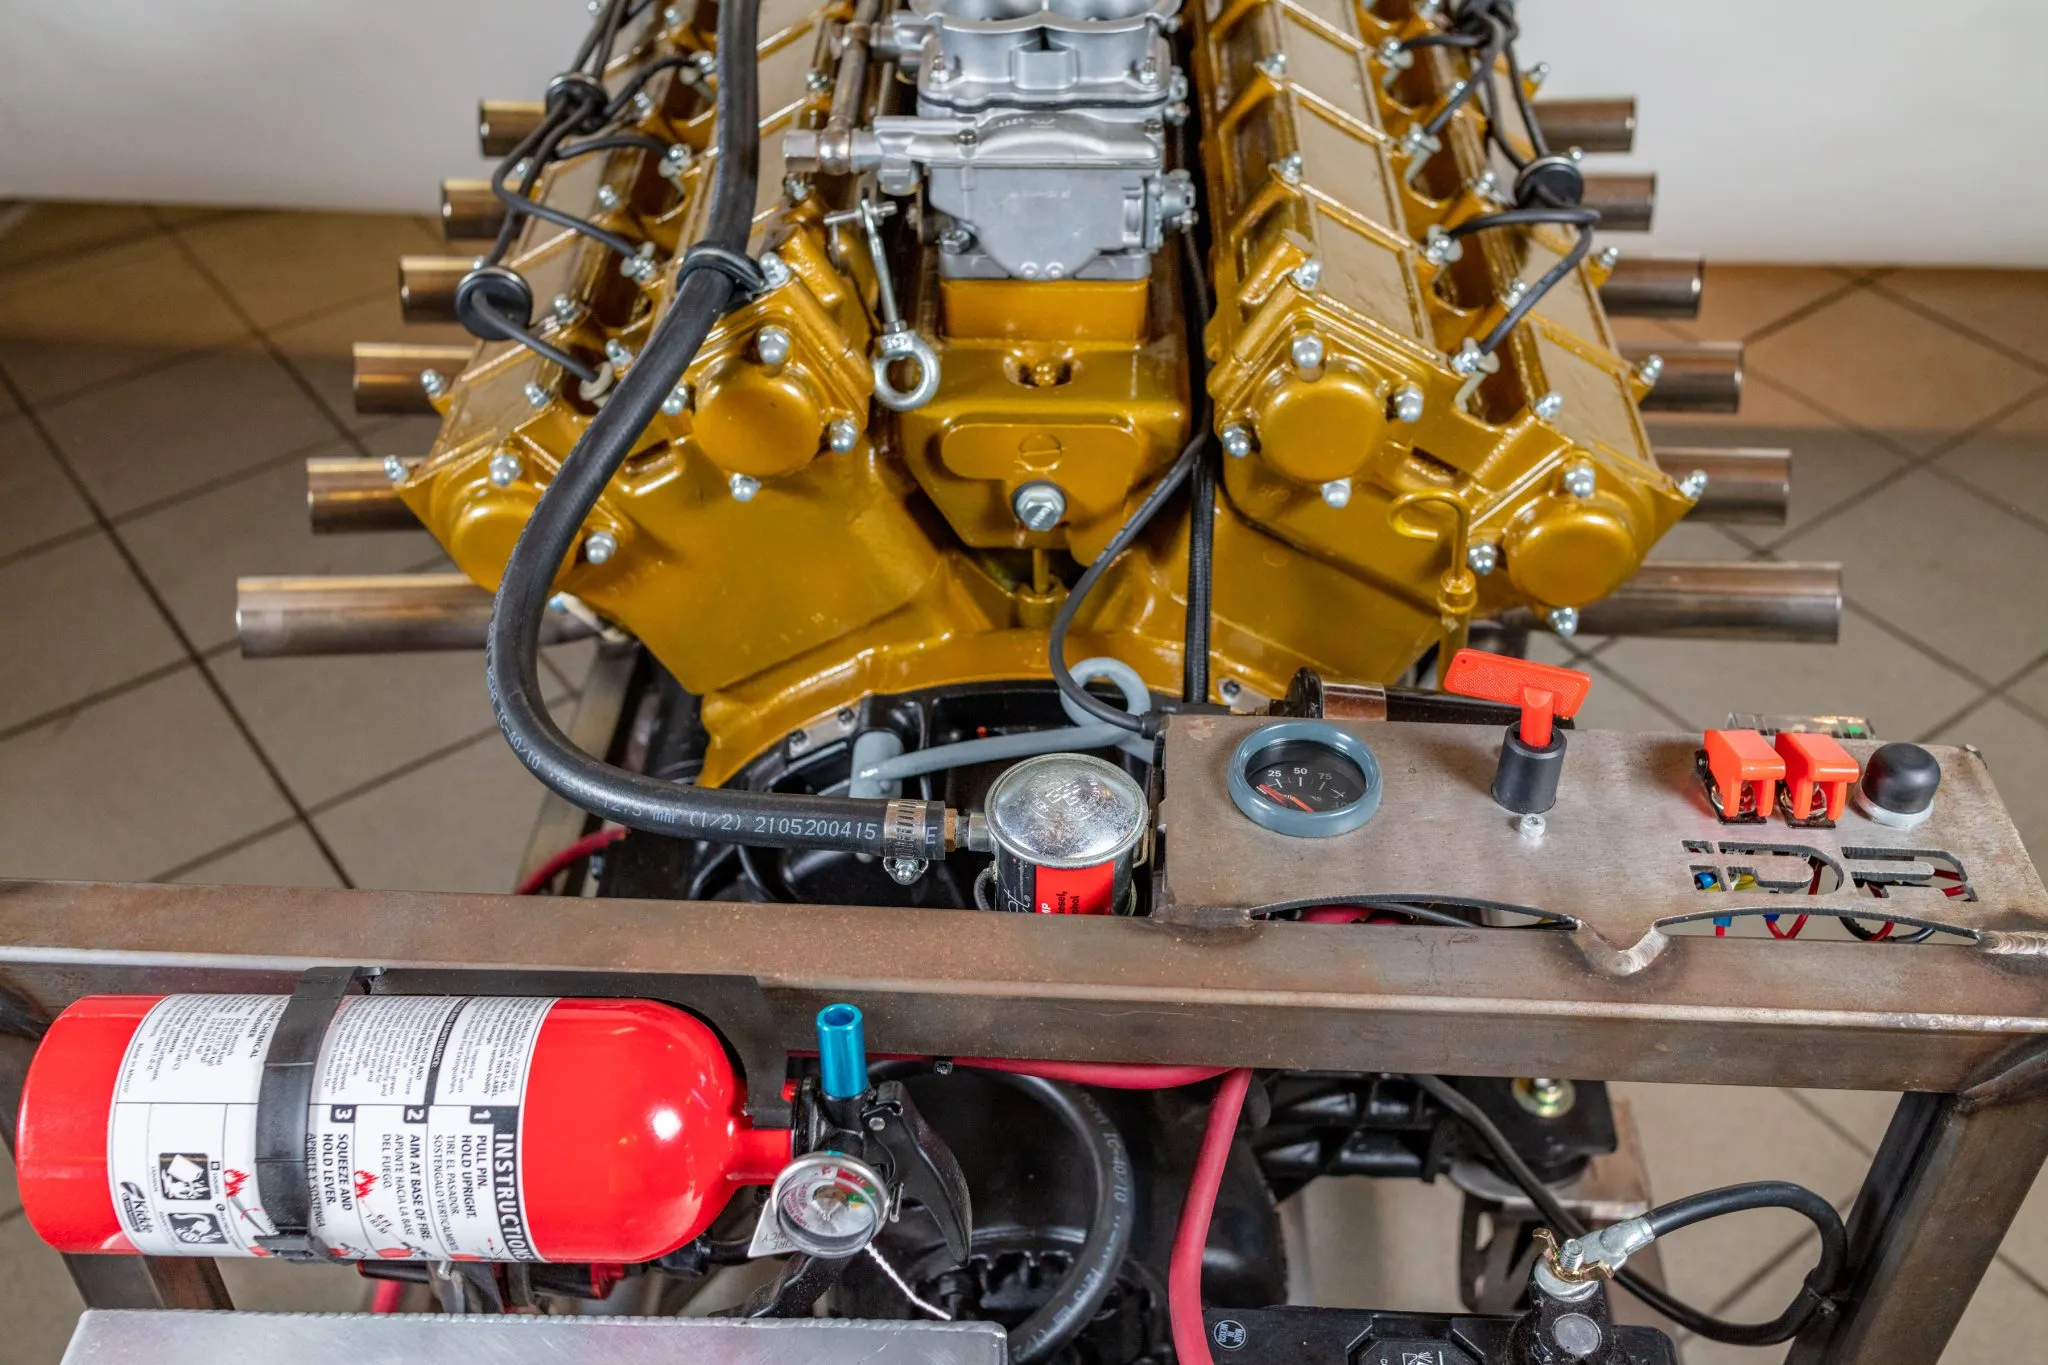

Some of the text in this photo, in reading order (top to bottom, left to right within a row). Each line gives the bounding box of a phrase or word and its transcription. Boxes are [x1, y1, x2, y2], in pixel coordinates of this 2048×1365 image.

[1267, 769, 1282, 778] 25
[1293, 767, 1308, 776] 50
[1318, 772, 1333, 781] 75
[690, 812, 741, 831] (1/2)
[754, 815, 878, 841] 2105200415
[1056, 891, 1068, 914] iesel,
[249, 1022, 271, 1058] CHEMICAL
[336, 1108, 352, 1120] 3
[407, 1108, 424, 1120] 2
[474, 1110, 491, 1119] 1
[322, 1134, 336, 1205] HOLD LEVER.
[337, 1134, 353, 1210] SQUEEZE AND
[382, 1134, 392, 1189] DEL FUEGO.
[446, 1134, 459, 1216] TIRE EL PASADOR.
[461, 1135, 477, 1218] HOLD UPRIGHT.
[476, 1135, 488, 1189] PULL PIN.
[394, 1134, 414, 1235] APUNTE HACIA LA BASE
[409, 1134, 432, 1241] AIM AT BASE OF FIRE.
[495, 1133, 534, 1259] INSTRUCTIONS
[133, 1200, 154, 1233] Kidde
